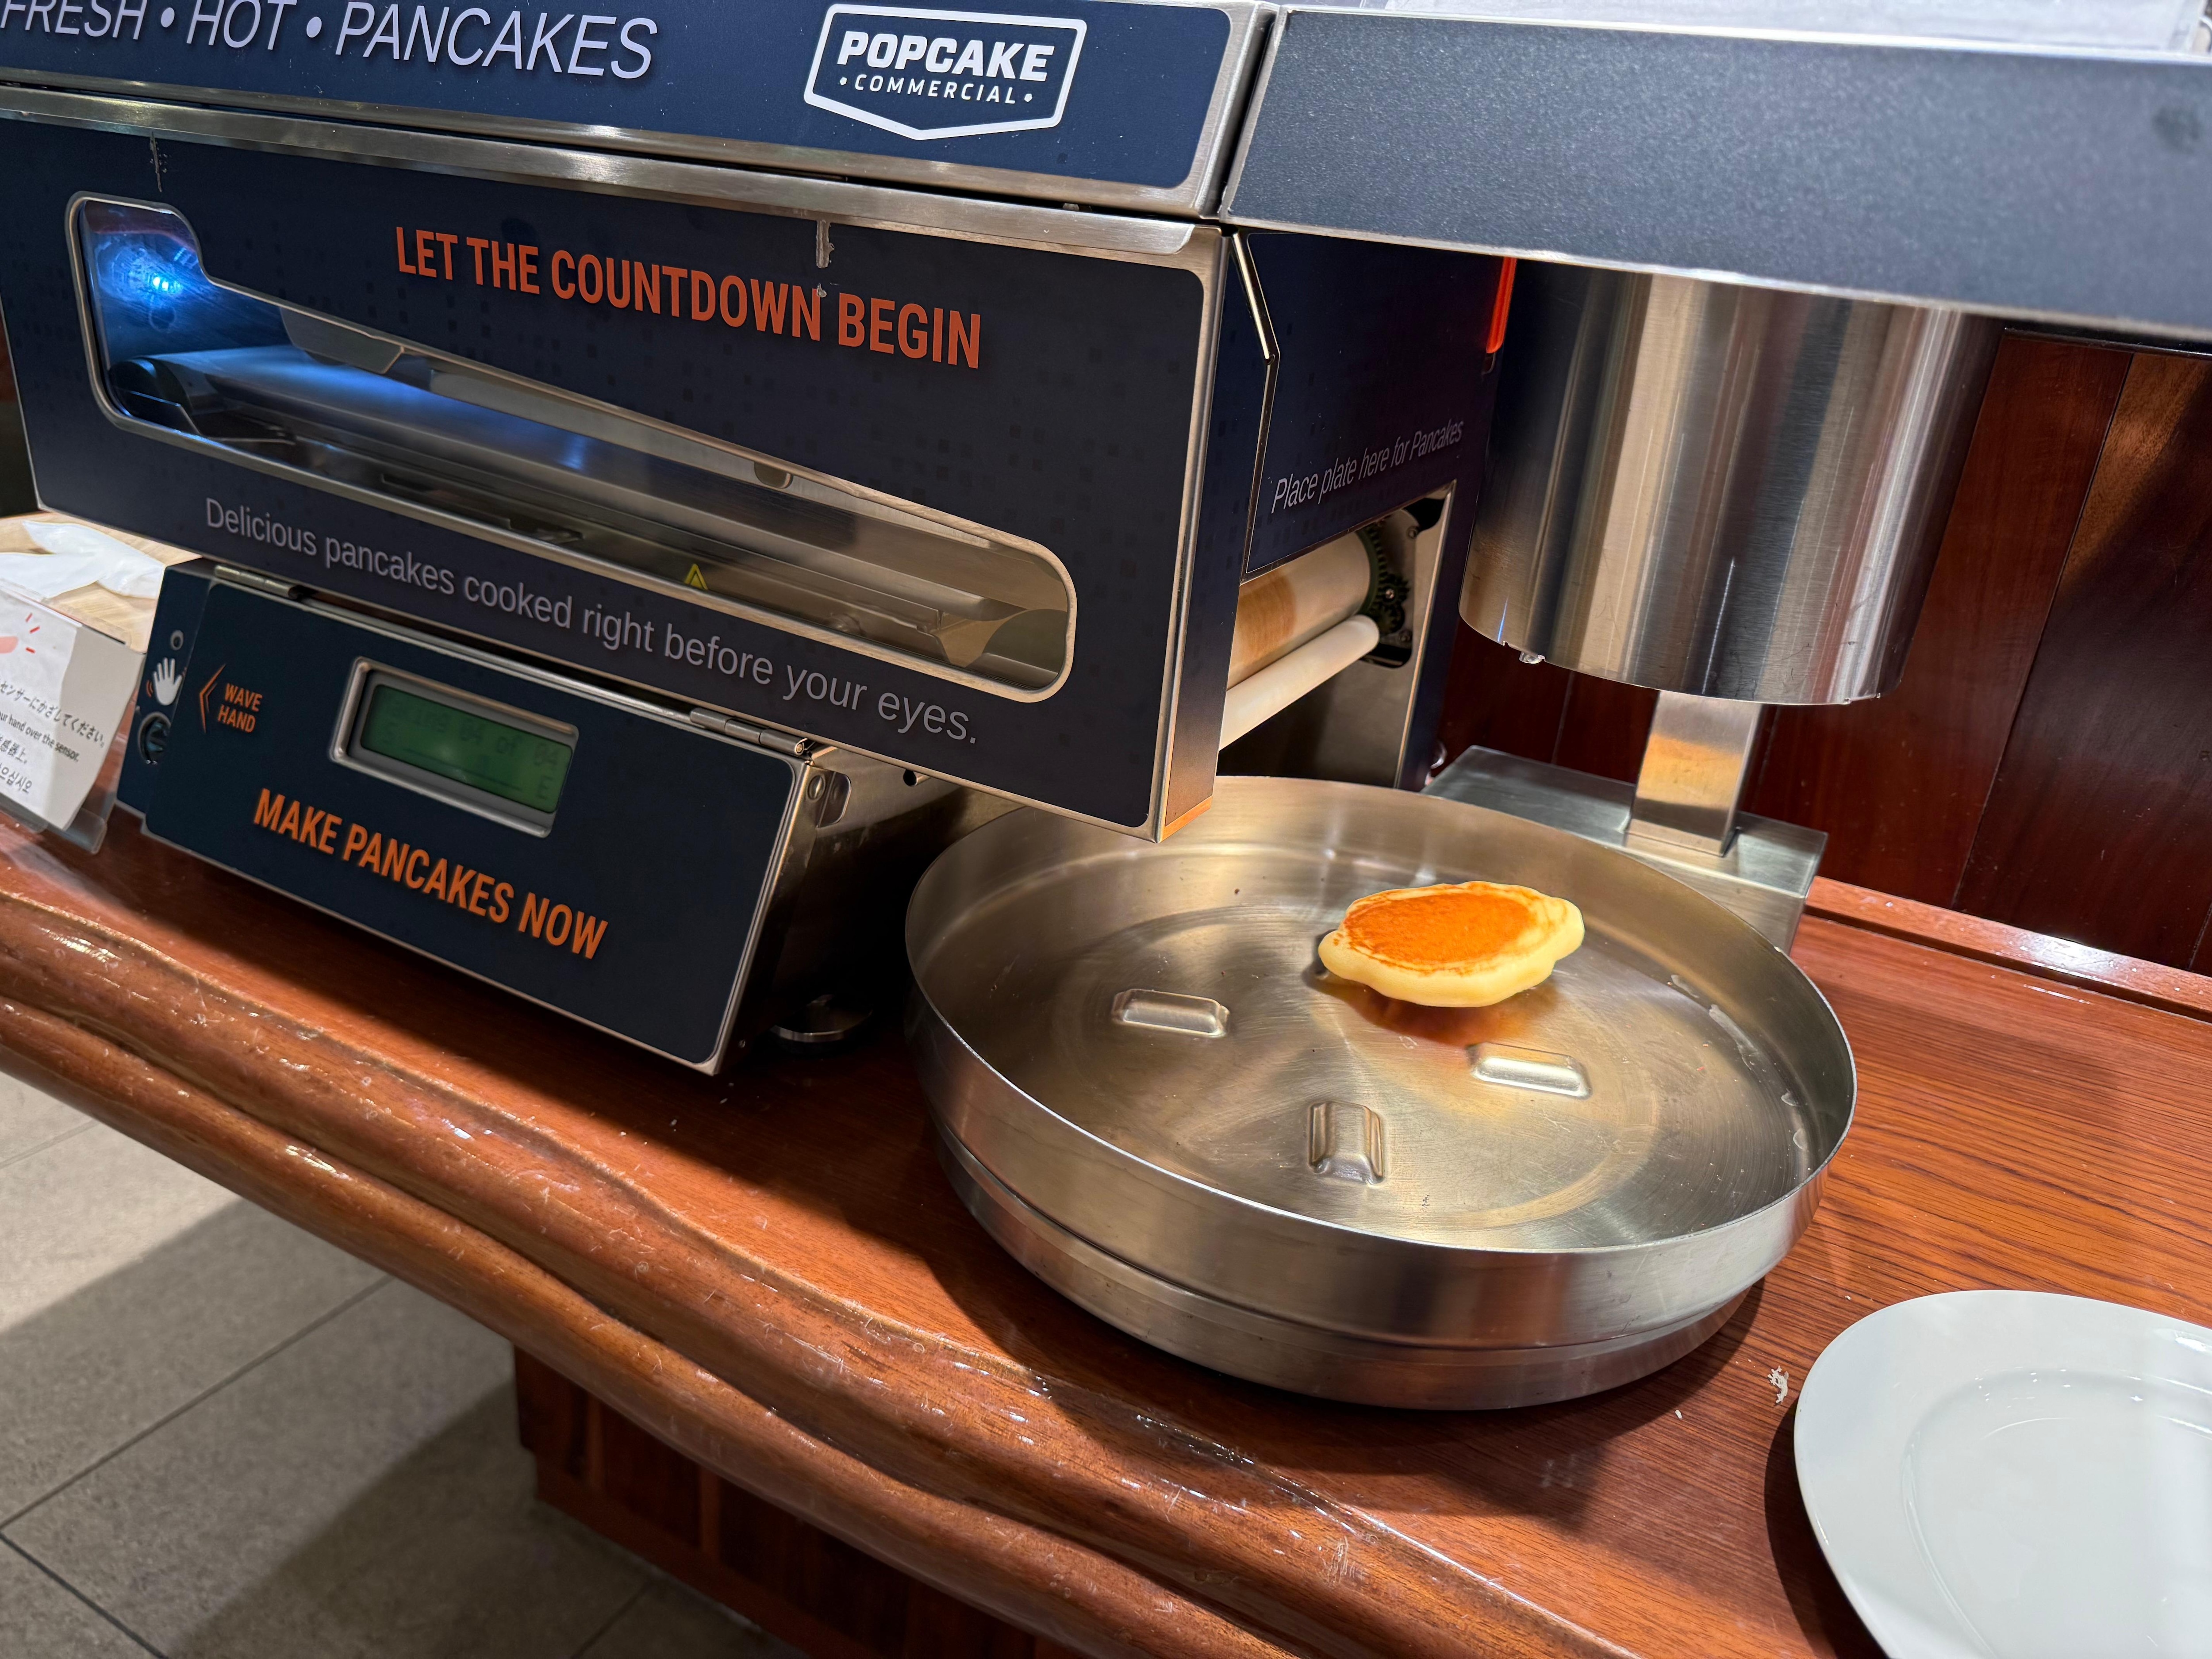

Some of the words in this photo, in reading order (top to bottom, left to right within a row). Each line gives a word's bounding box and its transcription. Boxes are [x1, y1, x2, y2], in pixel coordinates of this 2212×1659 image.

[0, 0, 147, 40] FRESH
[187, 0, 297, 50] HOT
[335, 2, 658, 80] PANCAKES
[837, 31, 1055, 81] POPCAKE
[855, 74, 1016, 104] COMMERCIAL
[396, 227, 458, 280] LET
[466, 237, 539, 294] THE
[551, 250, 820, 342] COUNTDOWN
[838, 292, 981, 369] BEGIN
[1271, 473, 1318, 514] Place
[1318, 456, 1357, 504] plate
[1358, 448, 1390, 480] here
[1390, 436, 1411, 468] for
[1409, 419, 1463, 460] Pancakes
[206, 498, 318, 557] Delicious
[325, 536, 455, 595] pancakes
[464, 576, 572, 630] cooked
[584, 603, 655, 652] right
[664, 623, 774, 685] before
[783, 664, 868, 710] your
[878, 691, 977, 745] eyes.
[218, 704, 256, 733] HAND
[225, 683, 263, 712] WAVE
[0, 710, 8, 722] ur
[8, 713, 27, 731] hand
[25, 726, 42, 740] over
[42, 733, 55, 748] the
[0, 763, 32, 794] 으십시오
[253, 788, 342, 855] MAKE
[342, 822, 515, 923] PANCAKES
[518, 892, 608, 959] NOW
